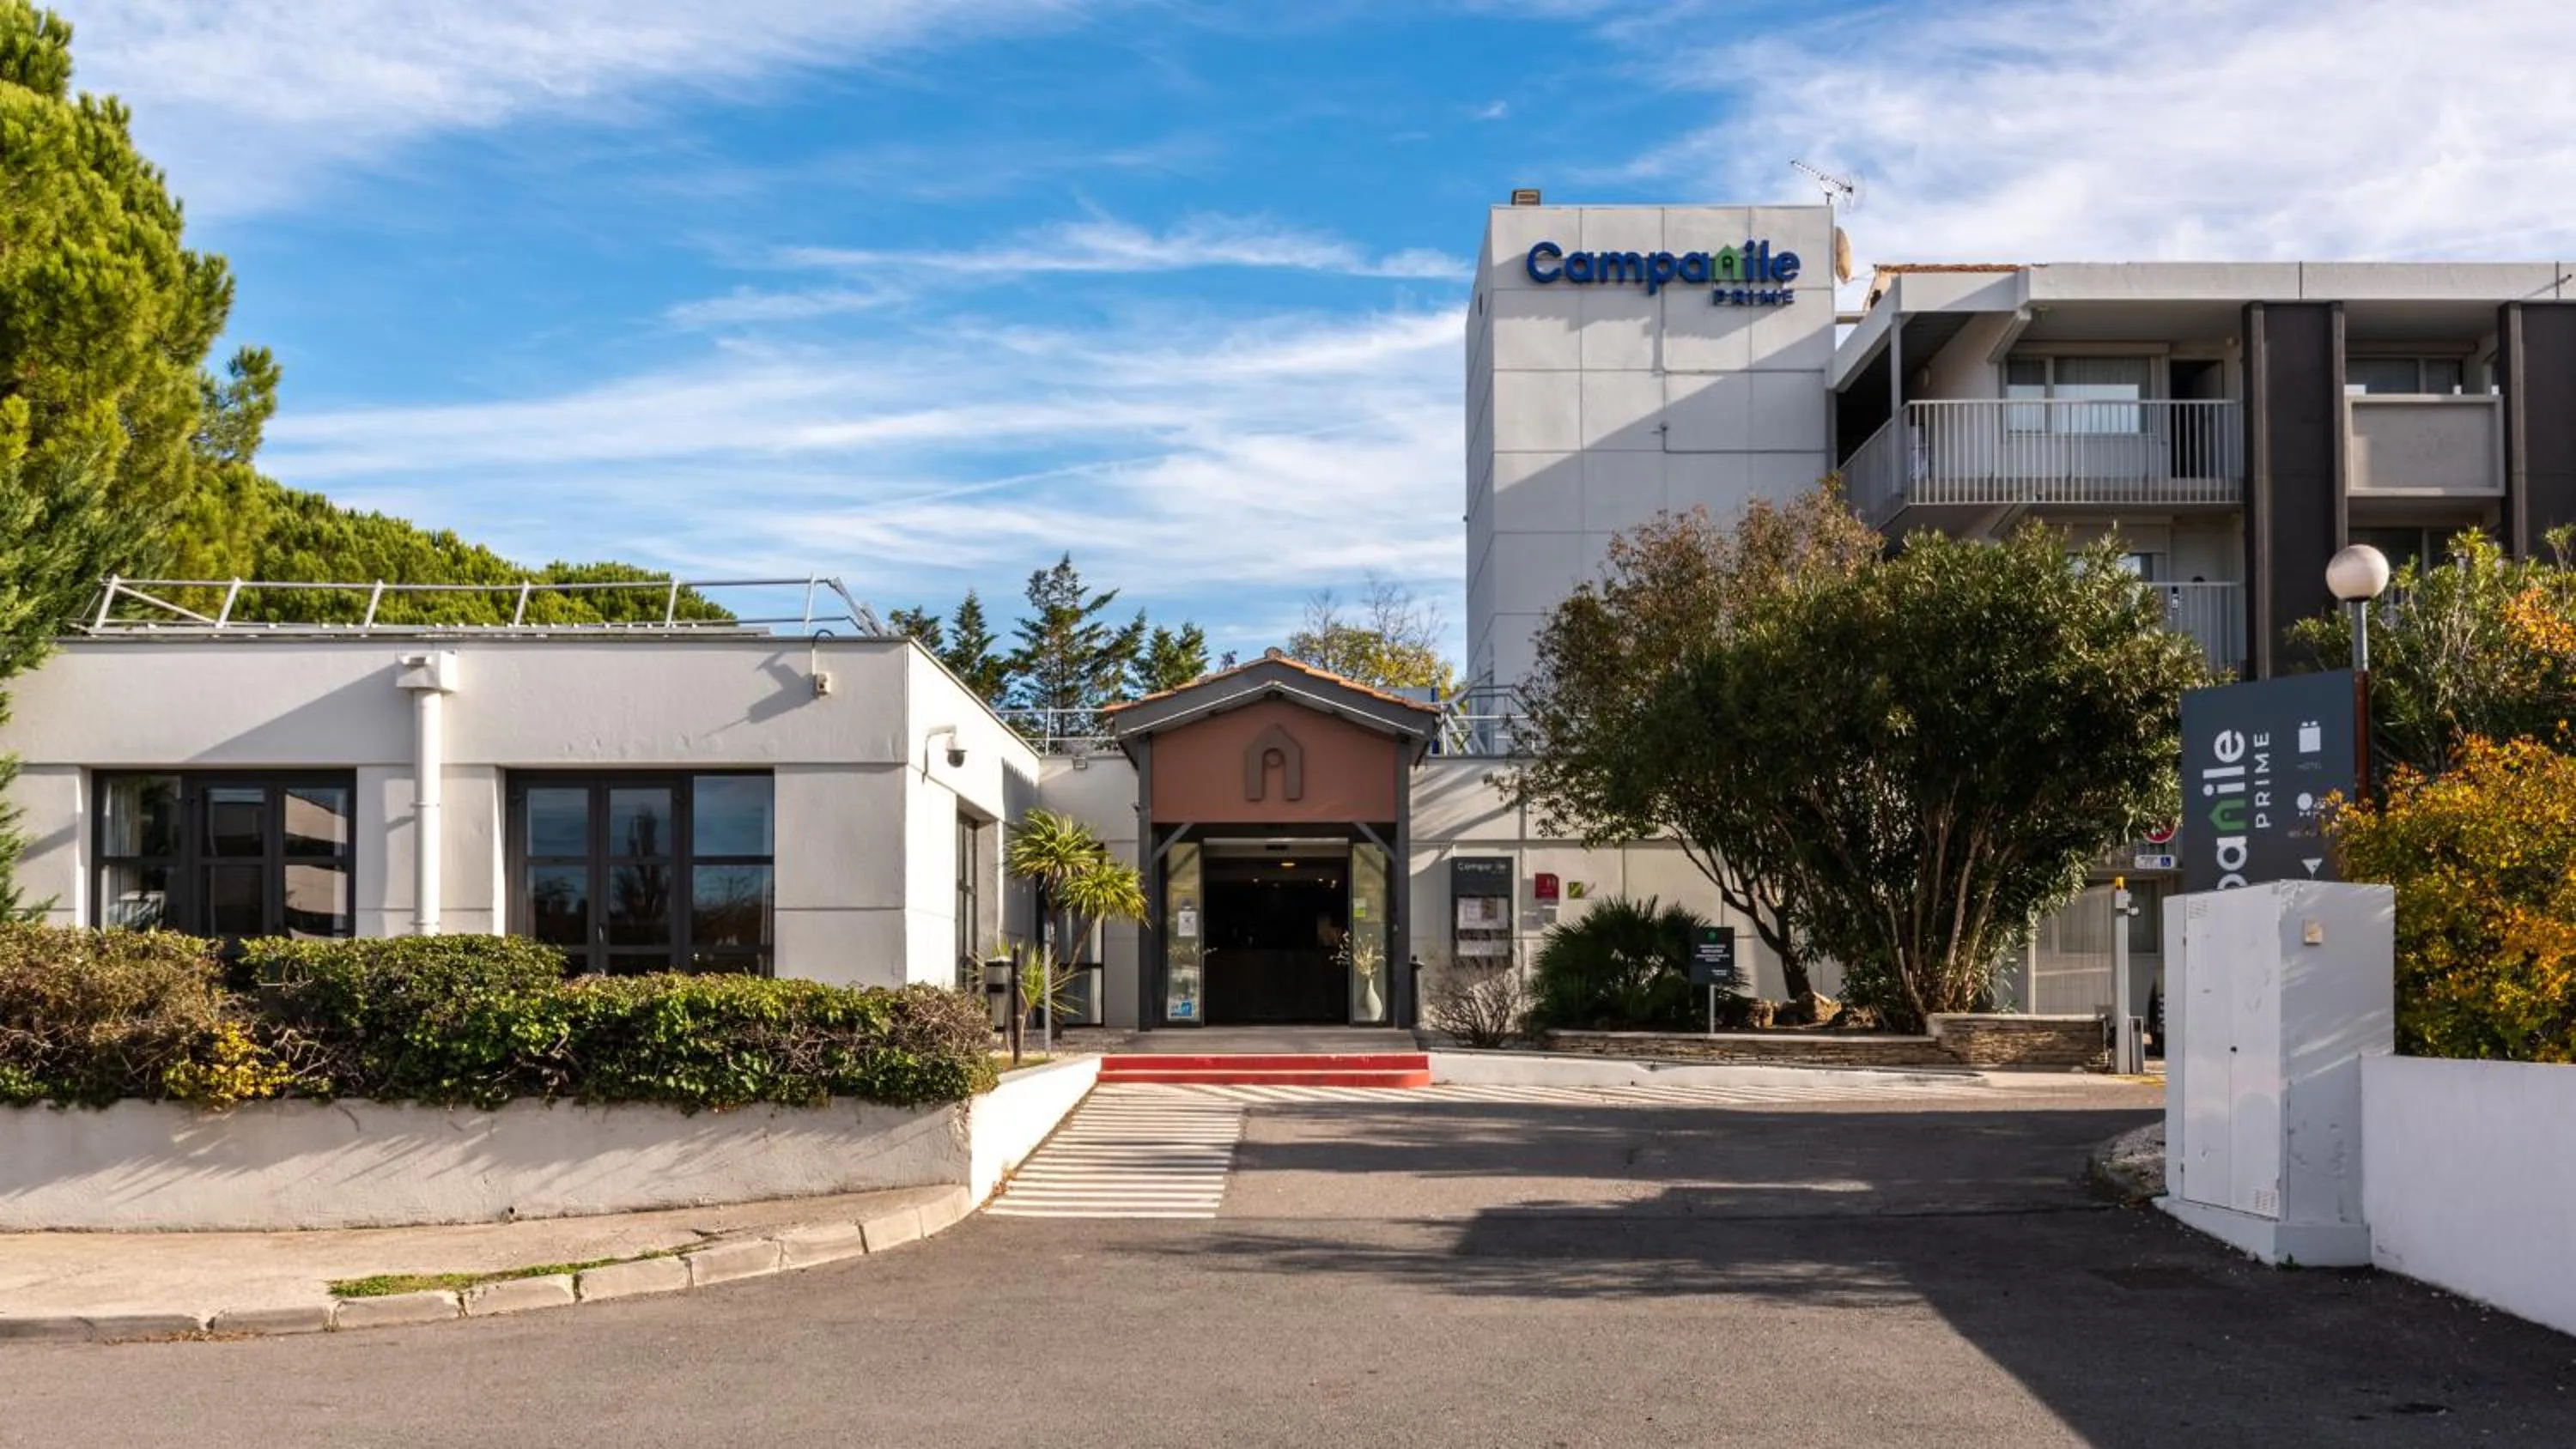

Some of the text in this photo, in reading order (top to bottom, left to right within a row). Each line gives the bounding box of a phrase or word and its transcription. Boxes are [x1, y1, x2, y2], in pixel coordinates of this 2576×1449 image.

[1526, 239, 1801, 295] Campanile
[1712, 288, 1795, 306] PRIME
[2254, 731, 2271, 828] PRIME
